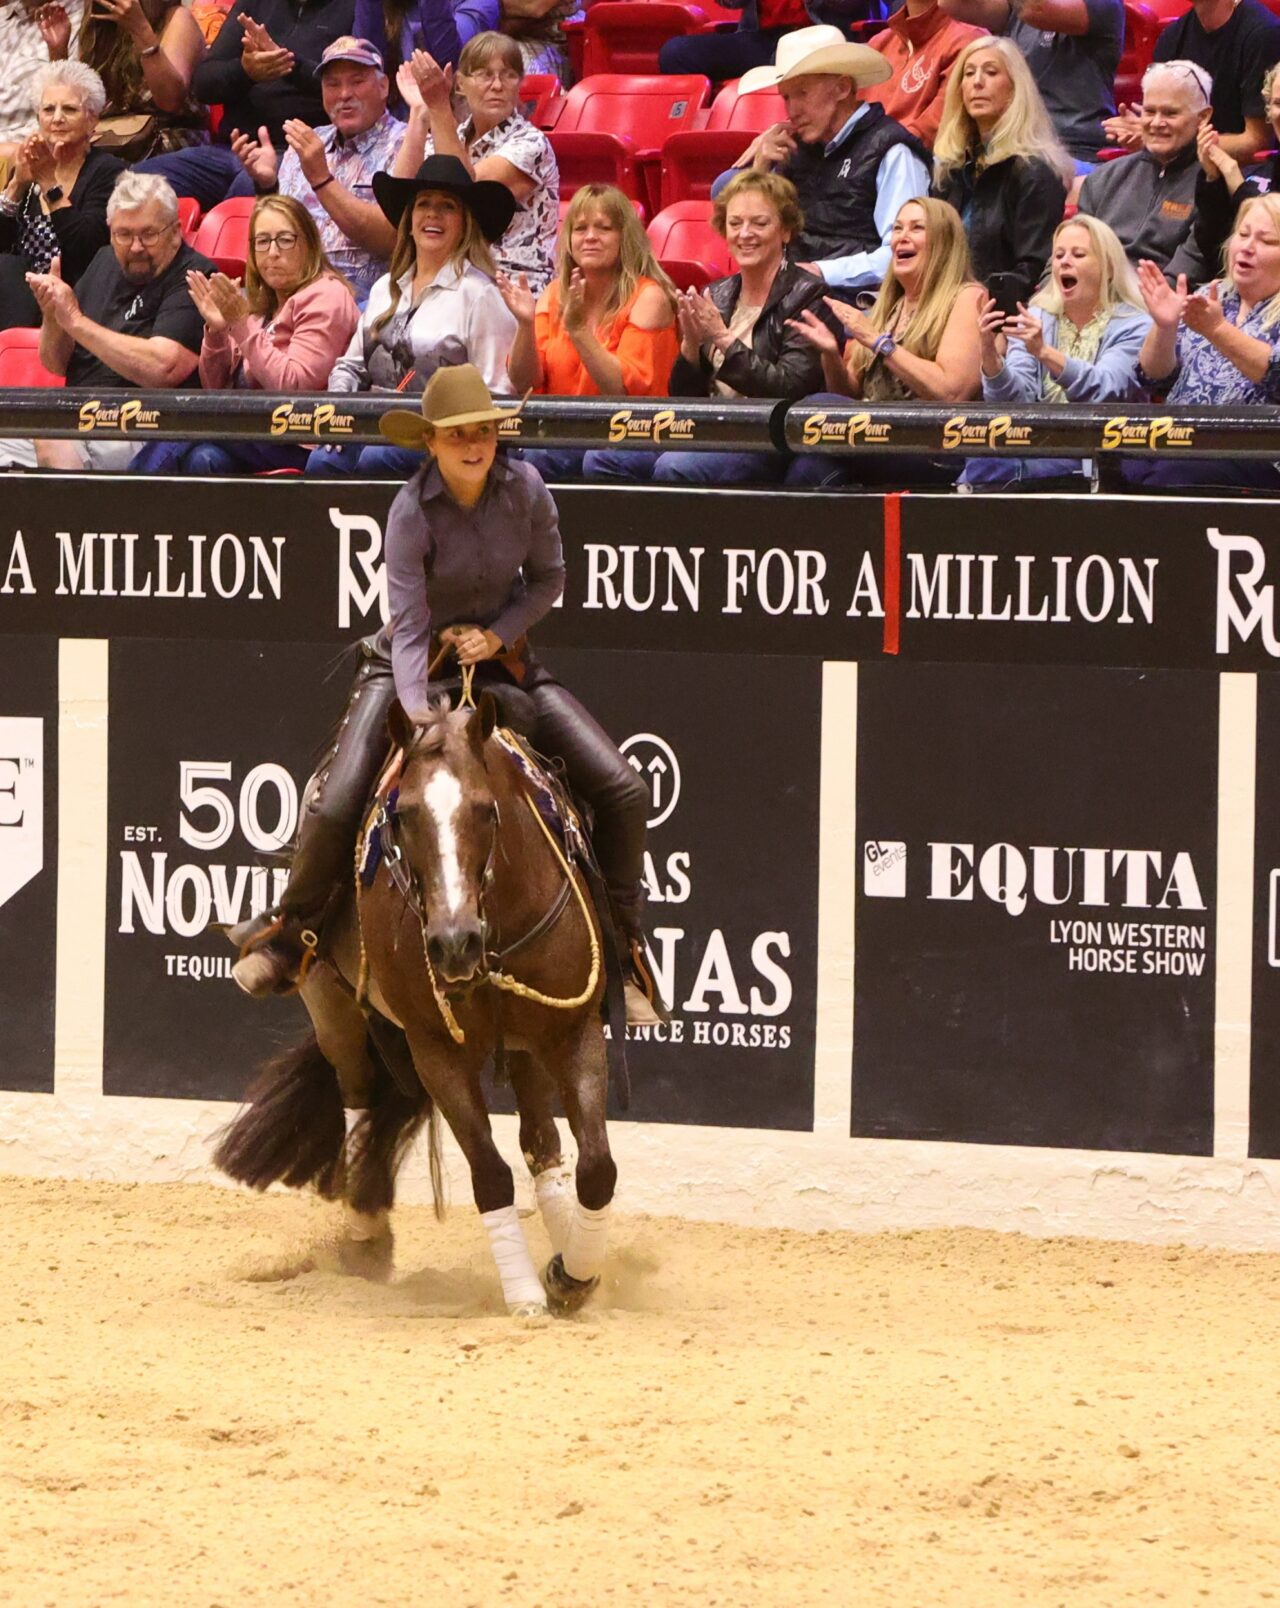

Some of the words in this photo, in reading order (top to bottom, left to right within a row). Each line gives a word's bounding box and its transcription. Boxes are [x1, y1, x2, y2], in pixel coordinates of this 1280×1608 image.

[1, 531, 36, 593] A
[55, 532, 285, 599] MILLION
[583, 543, 704, 612] RUN
[722, 547, 829, 615] FOR
[847, 551, 885, 618] A
[906, 553, 1158, 623] MILLION
[124, 825, 162, 842] EST.
[180, 760, 299, 852] 50
[866, 839, 889, 863] GL
[926, 843, 1208, 917] EQUITA
[1050, 919, 1101, 945] LYON
[1107, 922, 1206, 949] WESTERN
[165, 955, 233, 981] TEQUIL
[1069, 947, 1138, 973] HORSE
[1142, 950, 1206, 977] SHOW
[693, 1021, 791, 1049] HORSES
